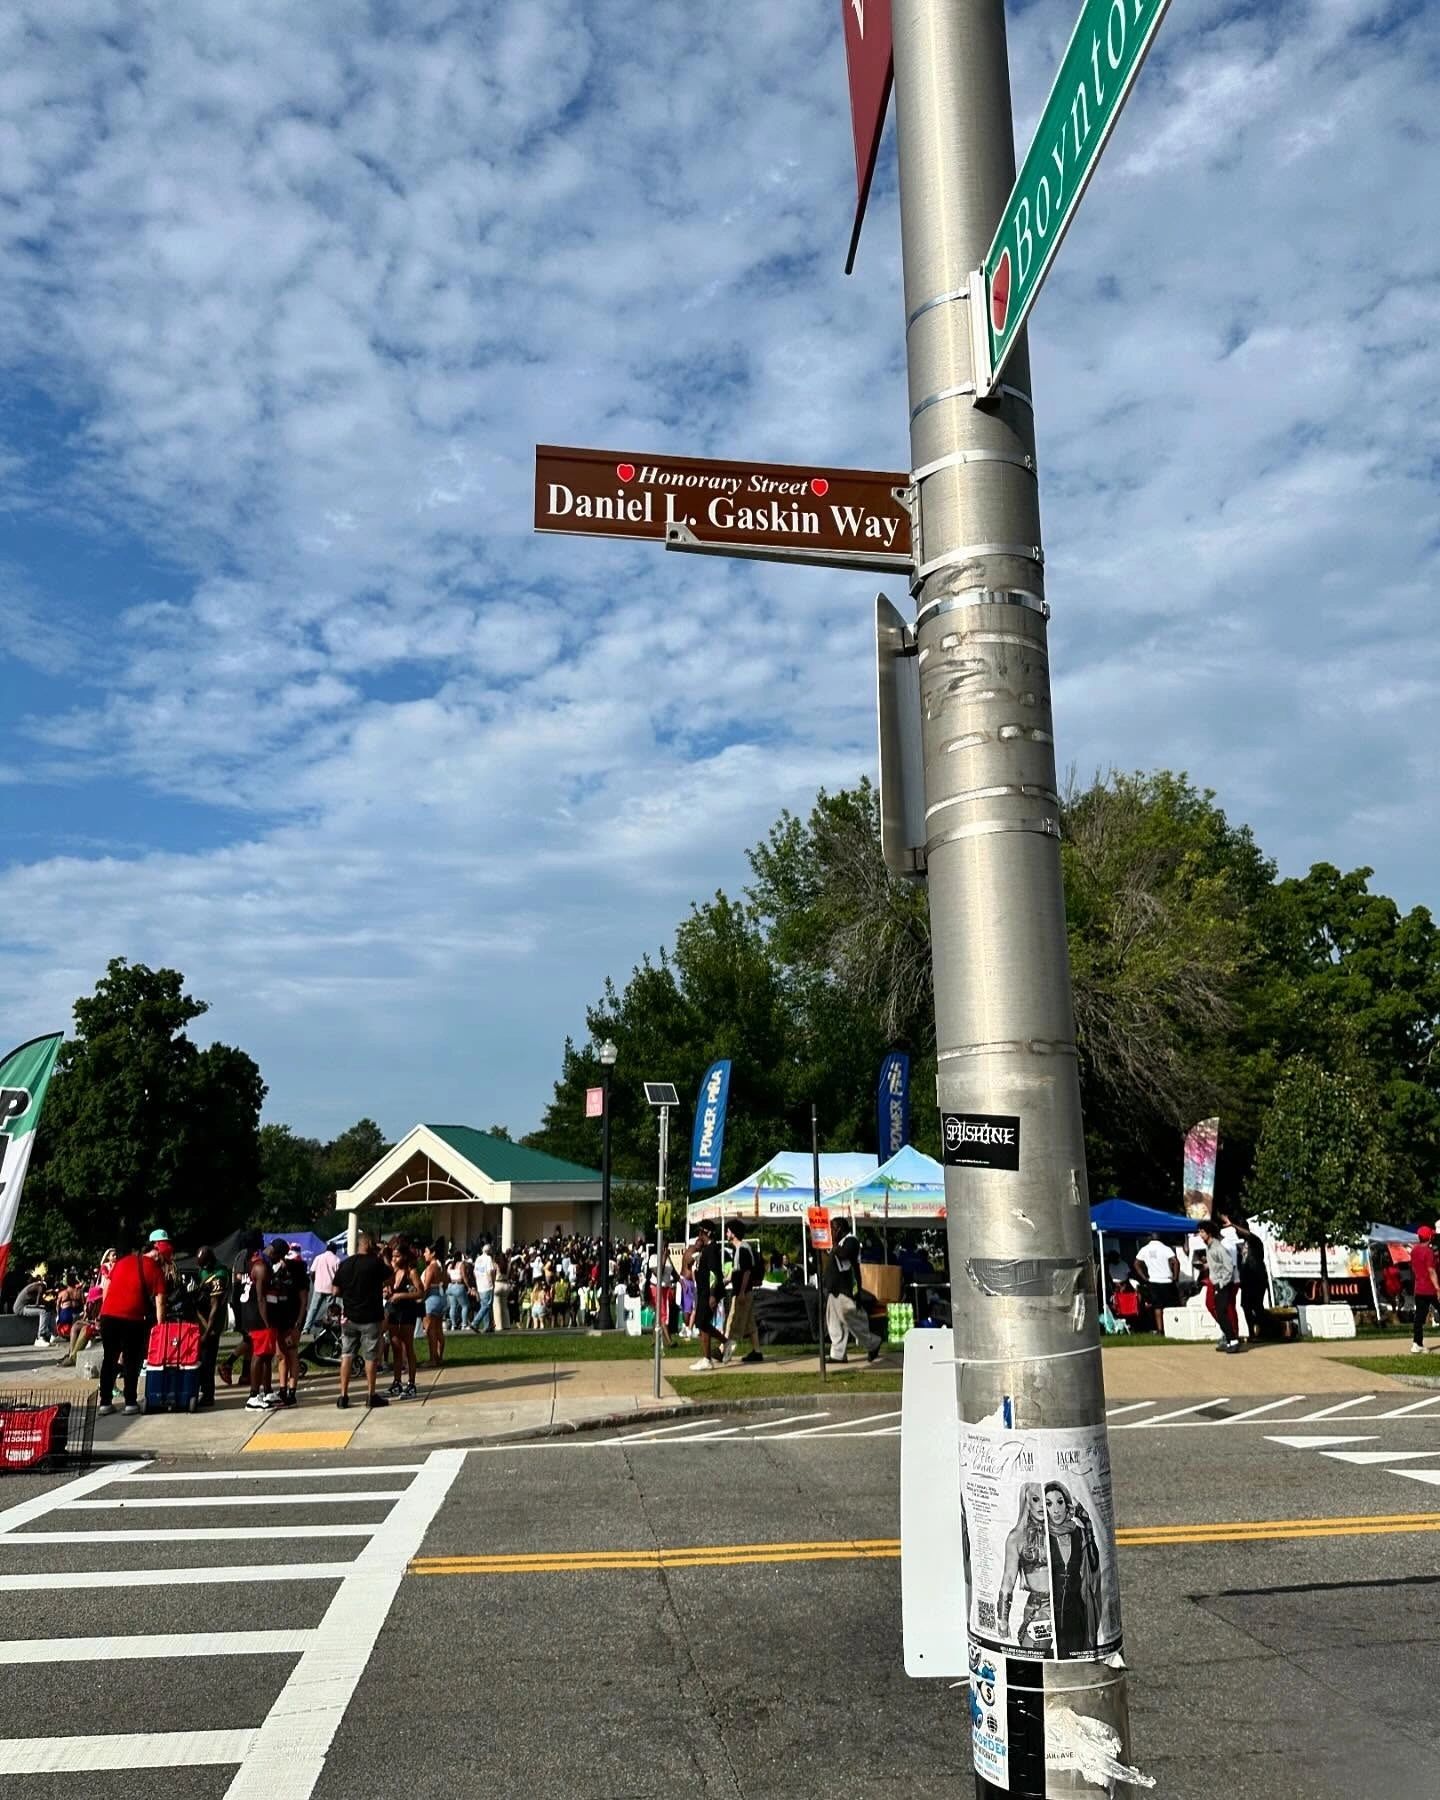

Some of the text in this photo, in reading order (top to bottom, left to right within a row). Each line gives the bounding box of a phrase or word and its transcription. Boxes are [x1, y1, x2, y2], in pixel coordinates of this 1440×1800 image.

[1013, 0, 1143, 291] Boynto
[638, 466, 809, 497] Honorary Street
[547, 483, 901, 547] Daniel L. Gaskin Way
[699, 1106, 717, 1157] POWER
